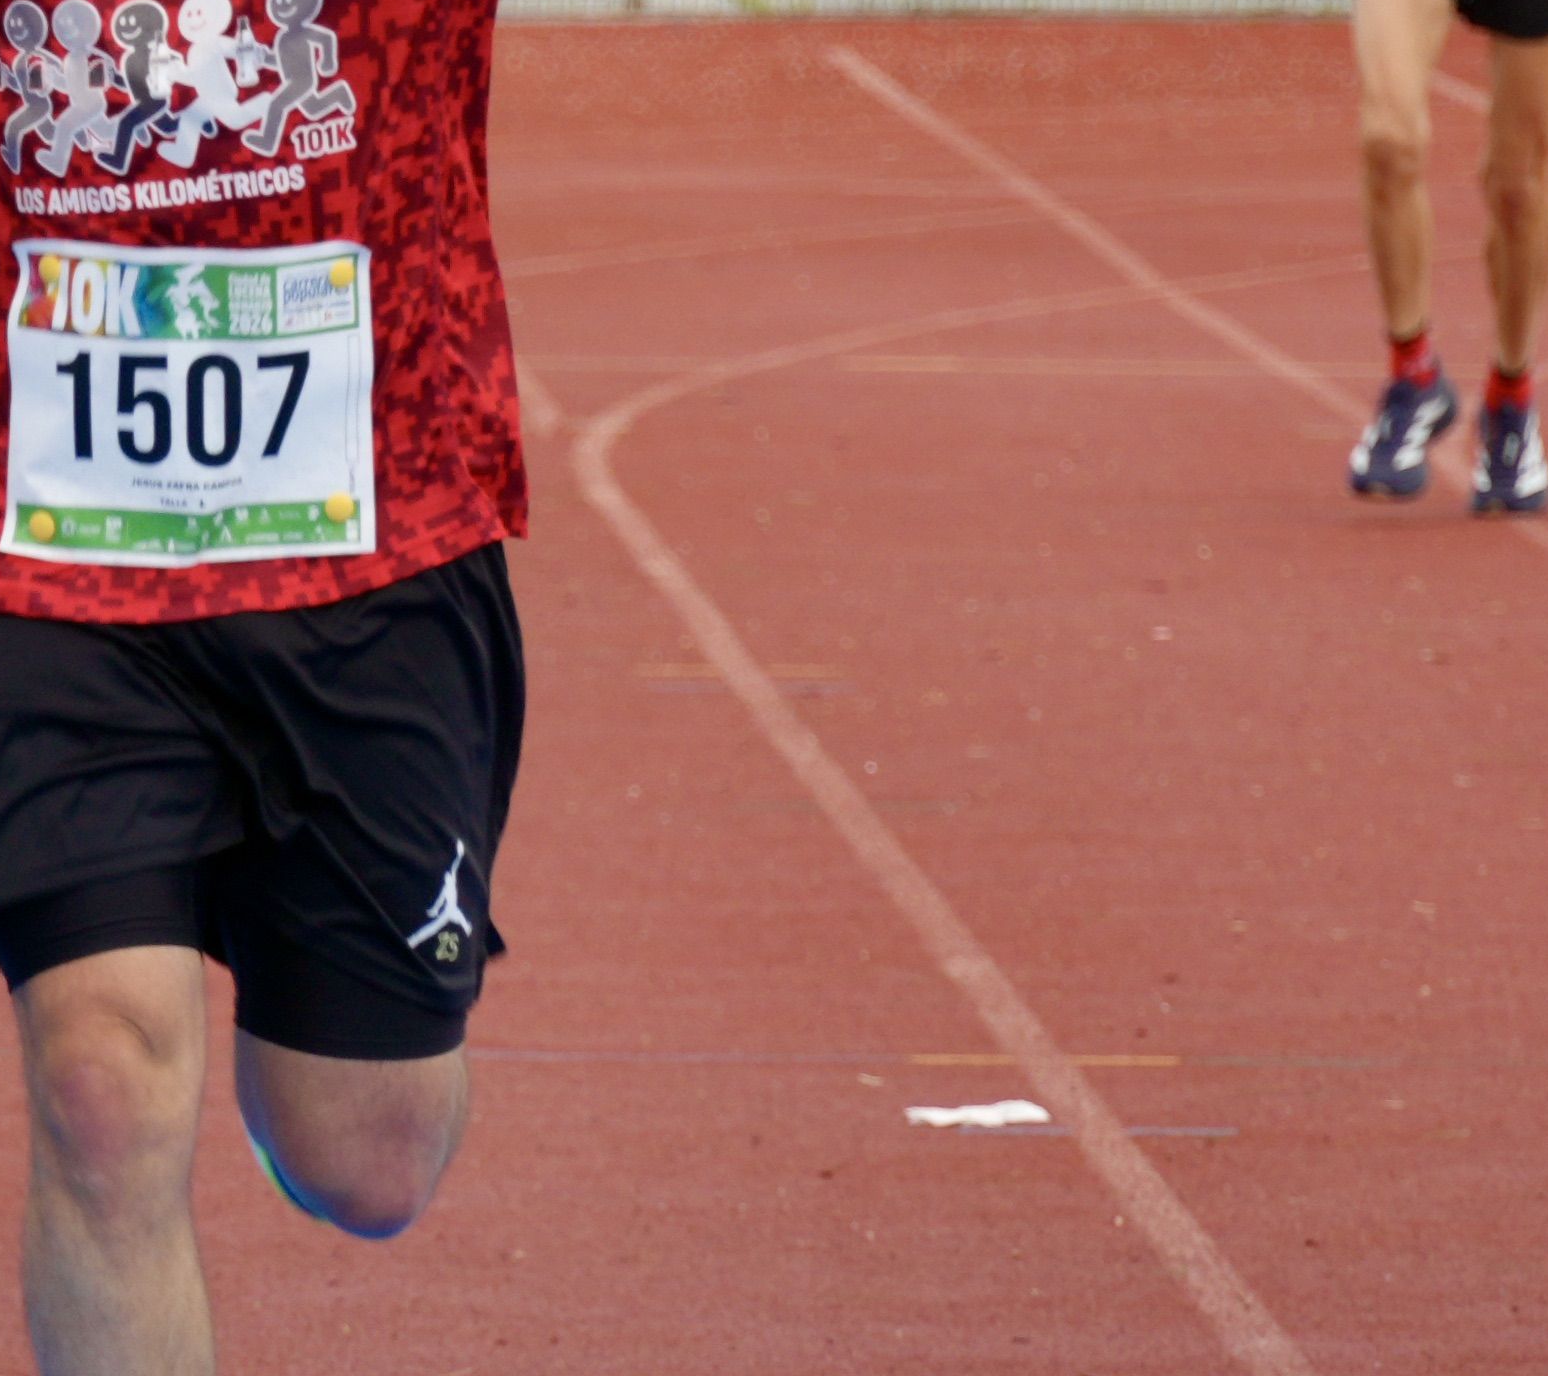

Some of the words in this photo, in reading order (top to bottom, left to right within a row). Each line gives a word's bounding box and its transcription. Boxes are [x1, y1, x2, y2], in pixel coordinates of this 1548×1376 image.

[291, 117, 356, 159] 101K
[15, 186, 47, 215] LOS
[47, 182, 133, 216] AMIGOS
[134, 164, 306, 210] KILOMÉTRICOS
[56, 350, 311, 467] 1507
